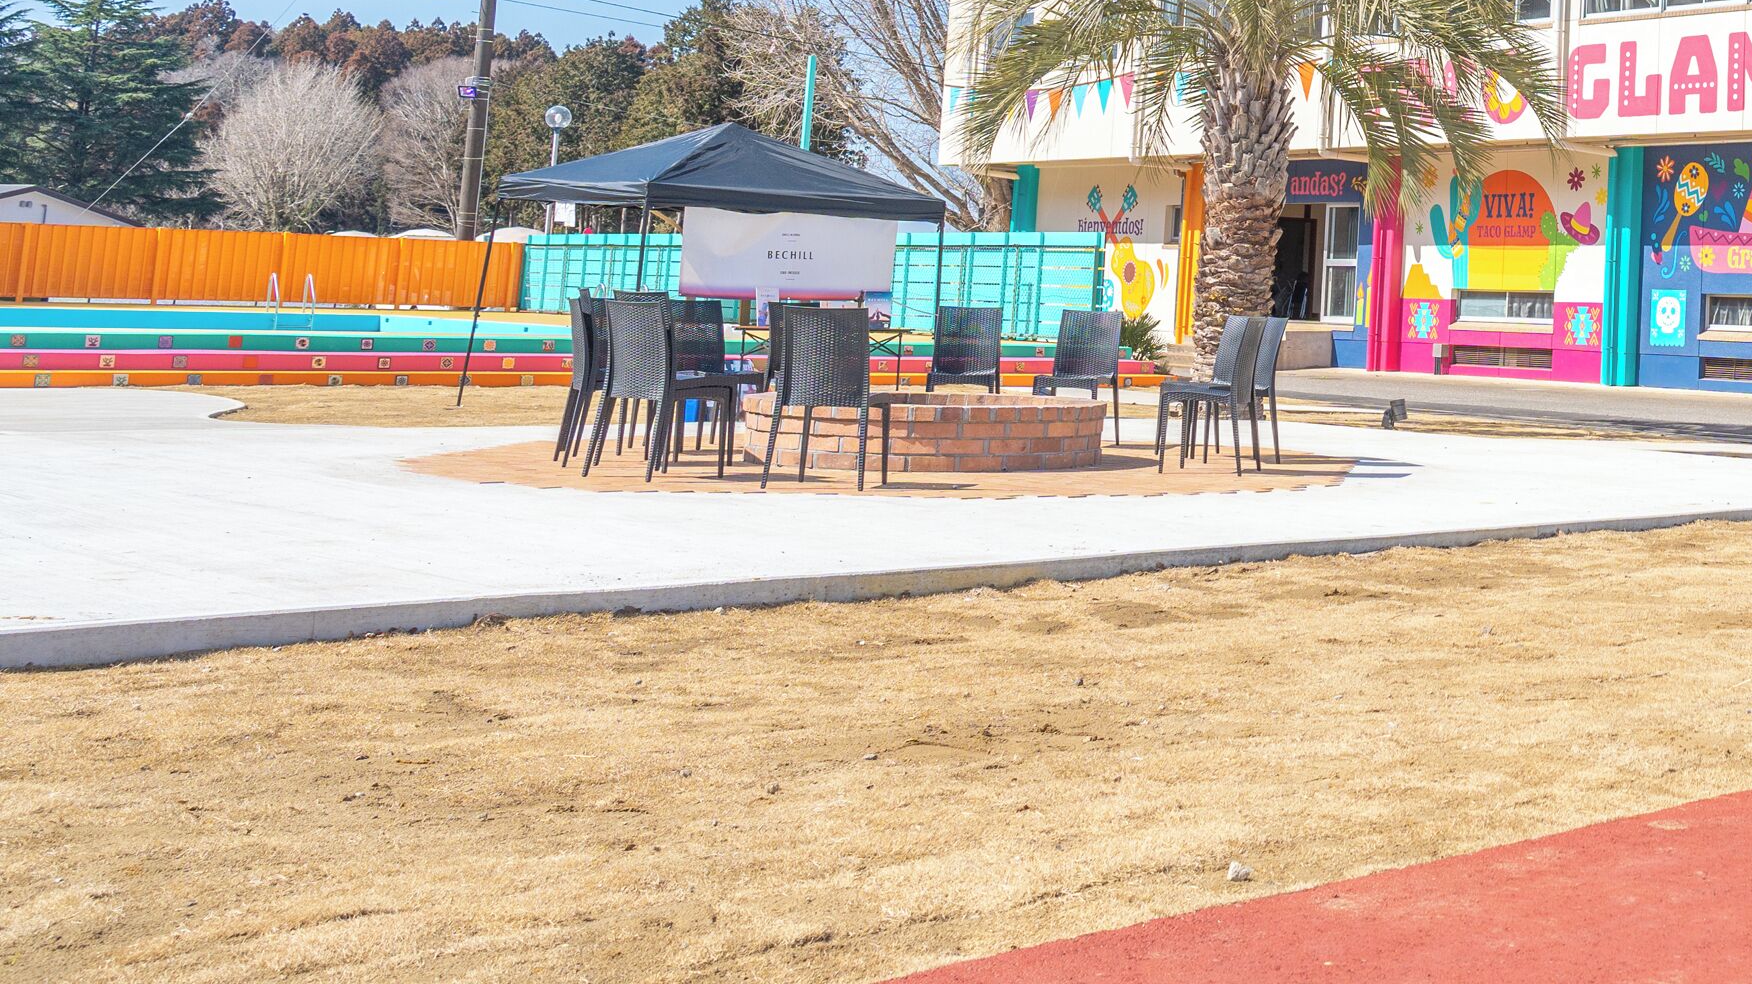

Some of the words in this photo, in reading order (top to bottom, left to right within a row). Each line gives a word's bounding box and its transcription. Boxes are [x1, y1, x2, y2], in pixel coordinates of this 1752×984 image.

[1290, 171, 1347, 197] andas?
[1483, 192, 1535, 219] VIVA!
[1477, 224, 1501, 238] TACO
[1503, 224, 1537, 239] GLAMP
[767, 250, 814, 260] BECHILL
